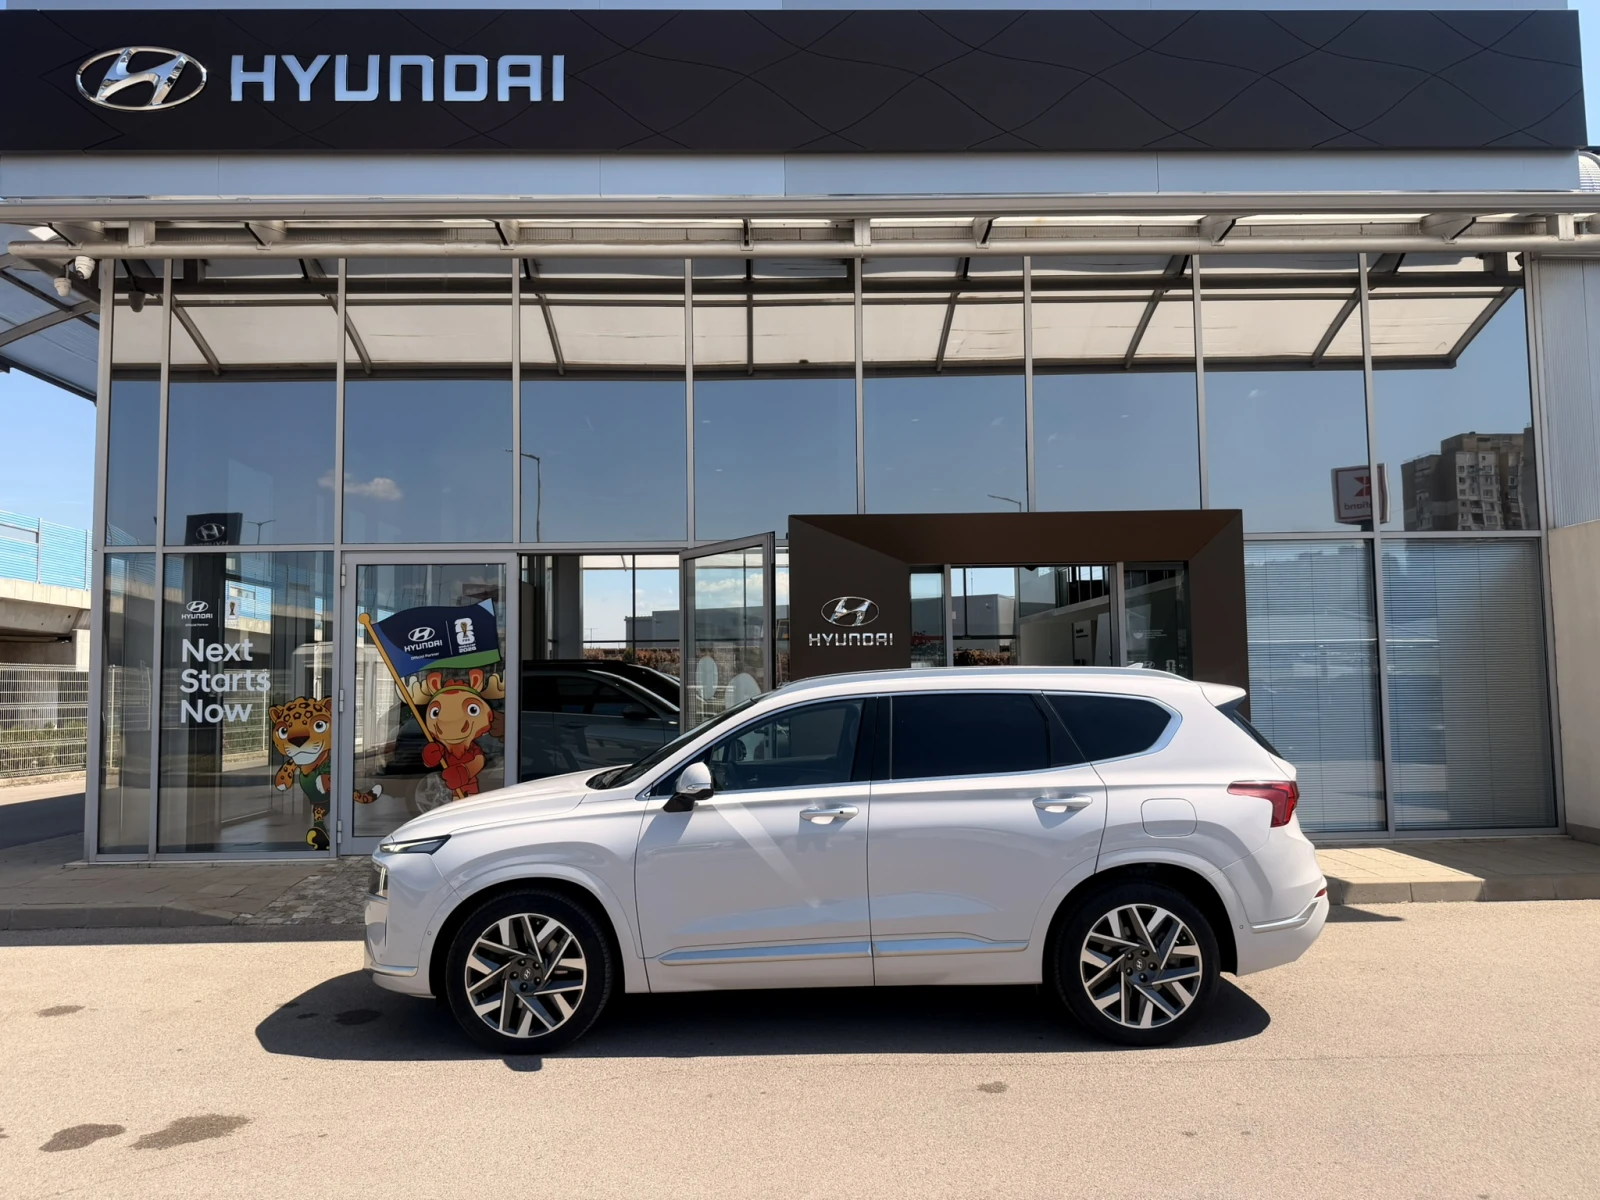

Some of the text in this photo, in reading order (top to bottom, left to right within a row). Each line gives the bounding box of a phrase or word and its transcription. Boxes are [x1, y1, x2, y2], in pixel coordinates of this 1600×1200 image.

[230, 54, 565, 101] HYUNDAI
[182, 638, 253, 662] Next
[404, 639, 443, 652] HYUNDAI
[808, 633, 893, 646] HYUNDAI
[180, 668, 271, 693] Starts
[181, 699, 252, 723] Now
